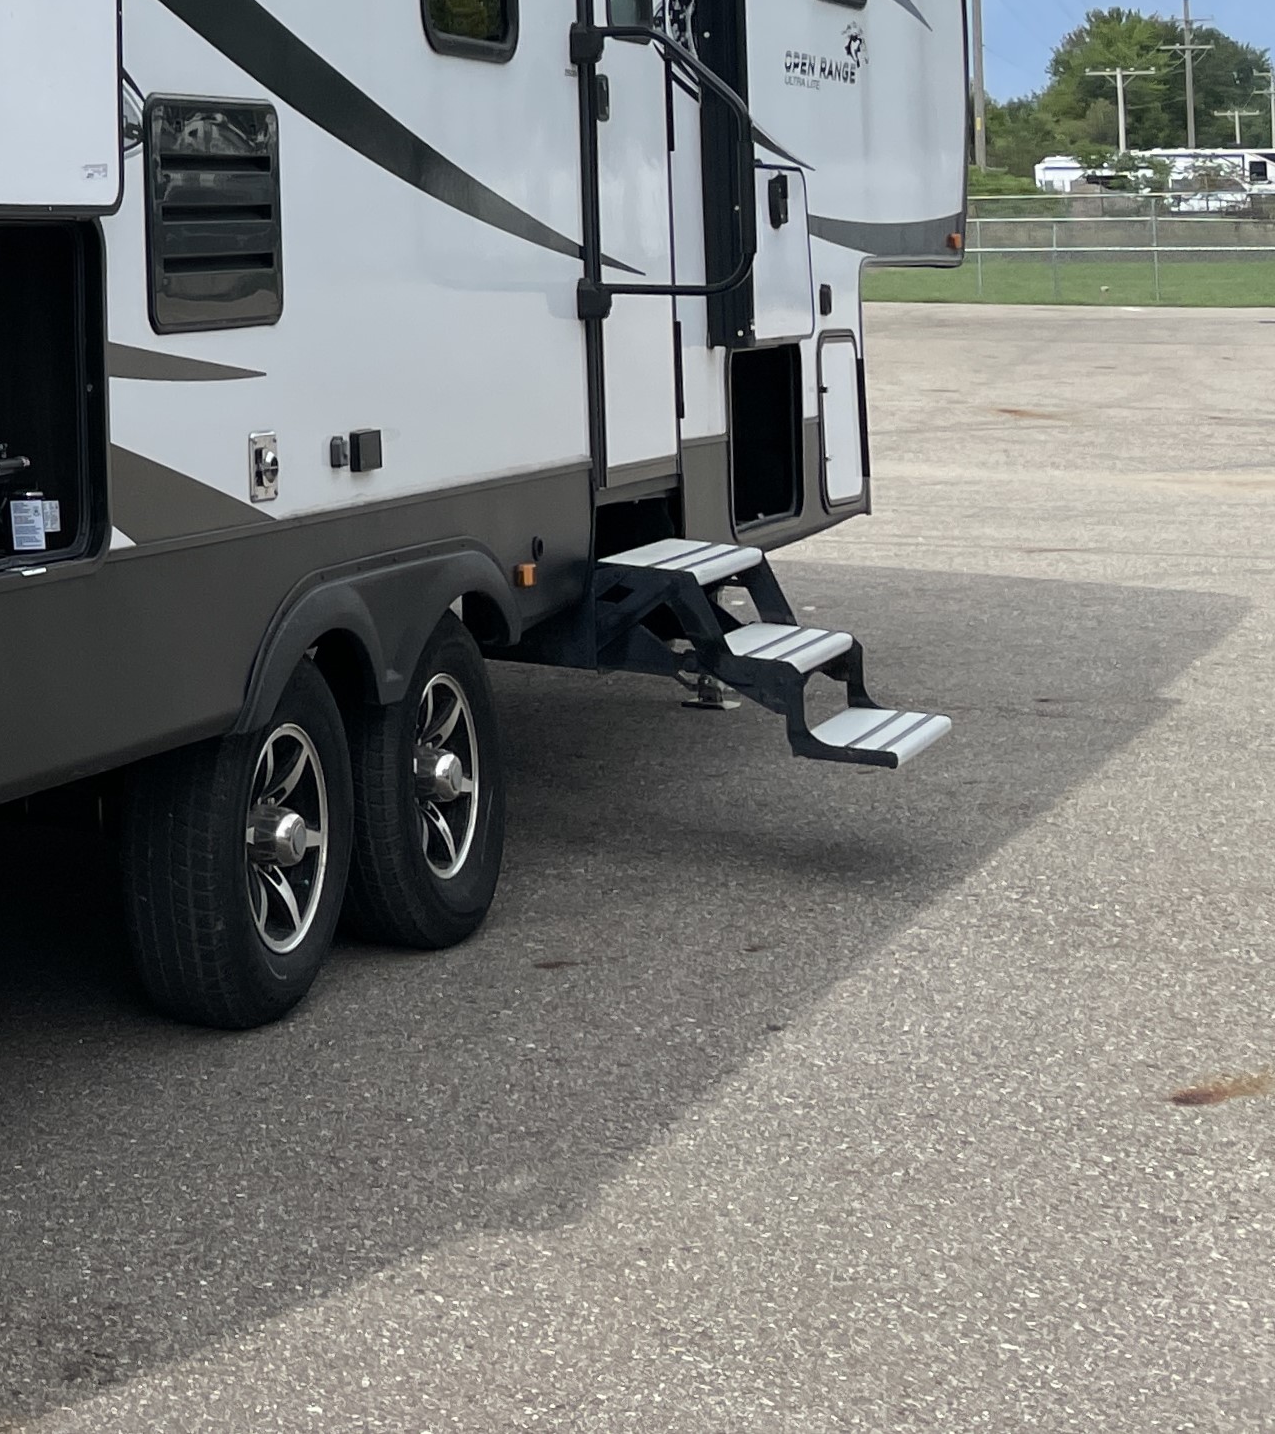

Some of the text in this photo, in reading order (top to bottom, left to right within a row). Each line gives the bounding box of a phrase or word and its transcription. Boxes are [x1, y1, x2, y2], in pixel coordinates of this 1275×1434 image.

[784, 50, 856, 84] OPEN RANGE
[784, 75, 806, 87] ULTRA
